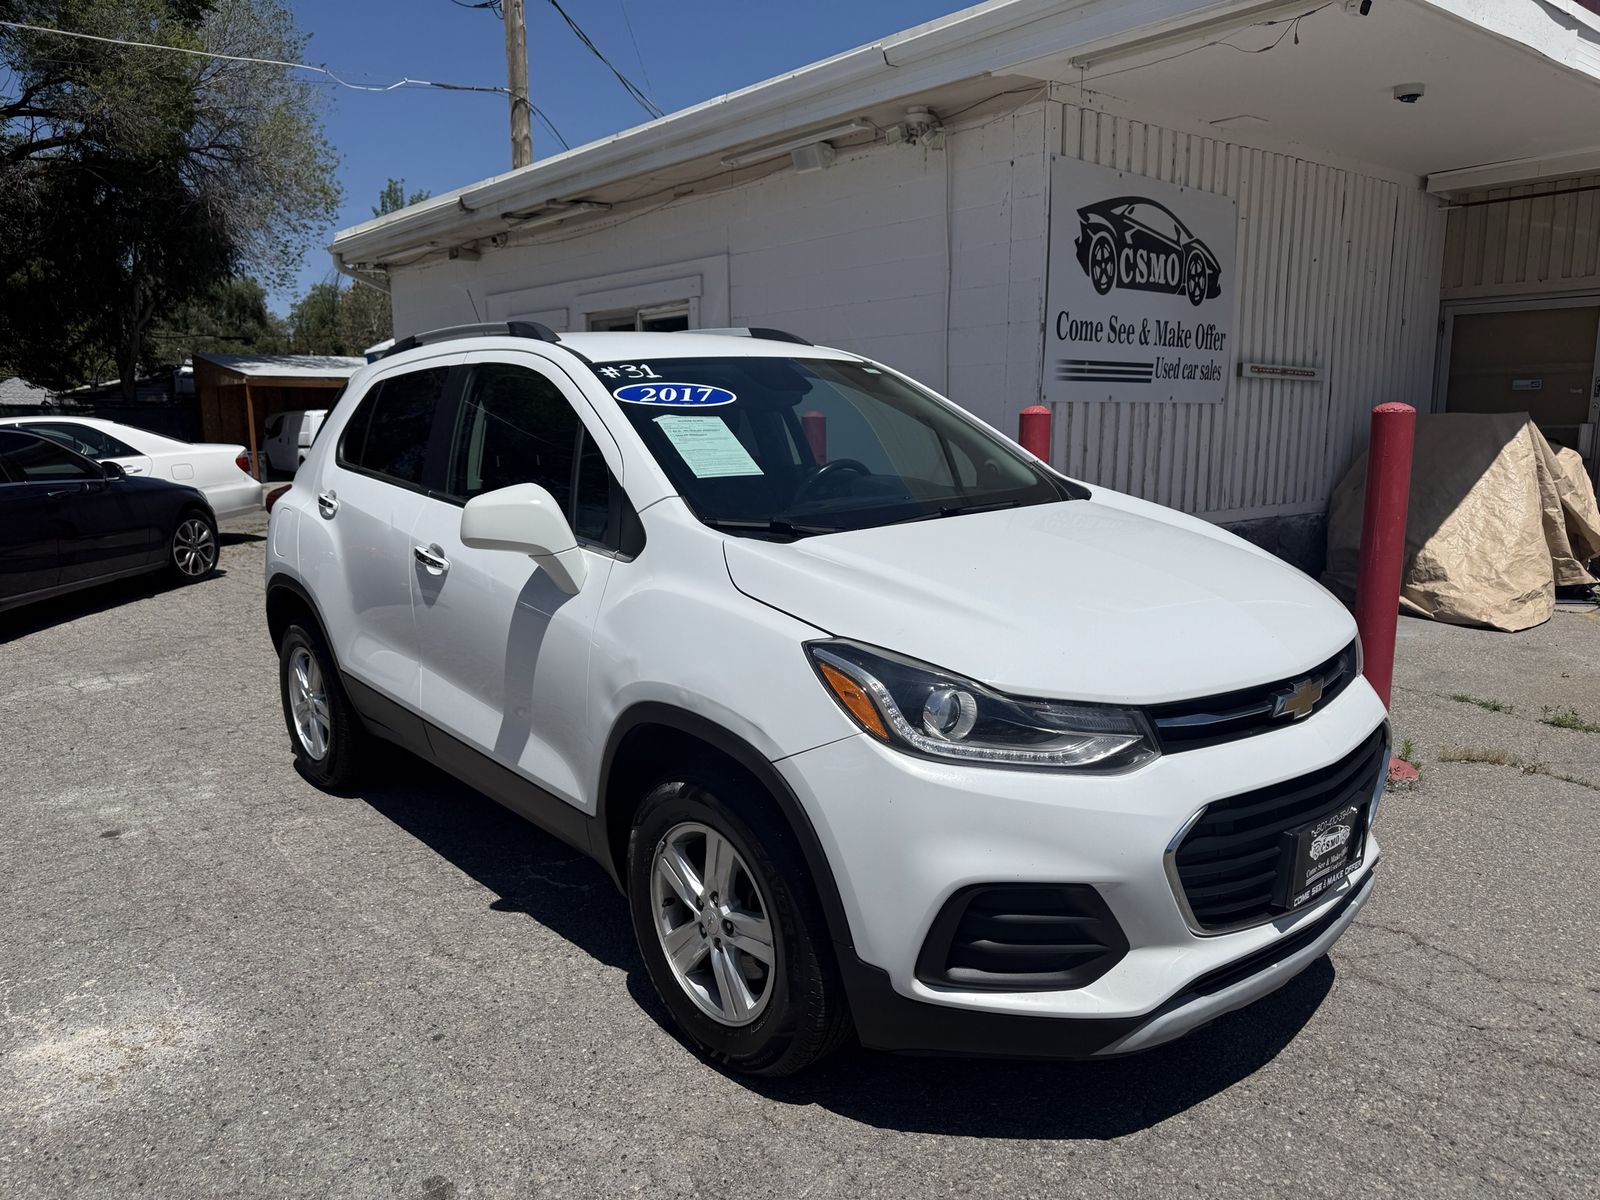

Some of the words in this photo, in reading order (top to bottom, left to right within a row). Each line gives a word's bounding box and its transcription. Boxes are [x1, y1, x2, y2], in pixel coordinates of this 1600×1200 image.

[1120, 247, 1180, 286] CSMO
[1056, 310, 1103, 342] Come
[1107, 314, 1135, 345] See
[1139, 318, 1150, 346] &
[1153, 319, 1191, 349] Make
[1195, 323, 1226, 351] Offer
[598, 363, 662, 378] #31
[1155, 356, 1181, 380] Used
[1182, 364, 1199, 380] car
[1199, 359, 1222, 382] sales
[640, 387, 713, 402] 2017
[1293, 890, 1311, 907] COME
[1311, 882, 1323, 896] SEE
[1327, 869, 1344, 887] MAKE
